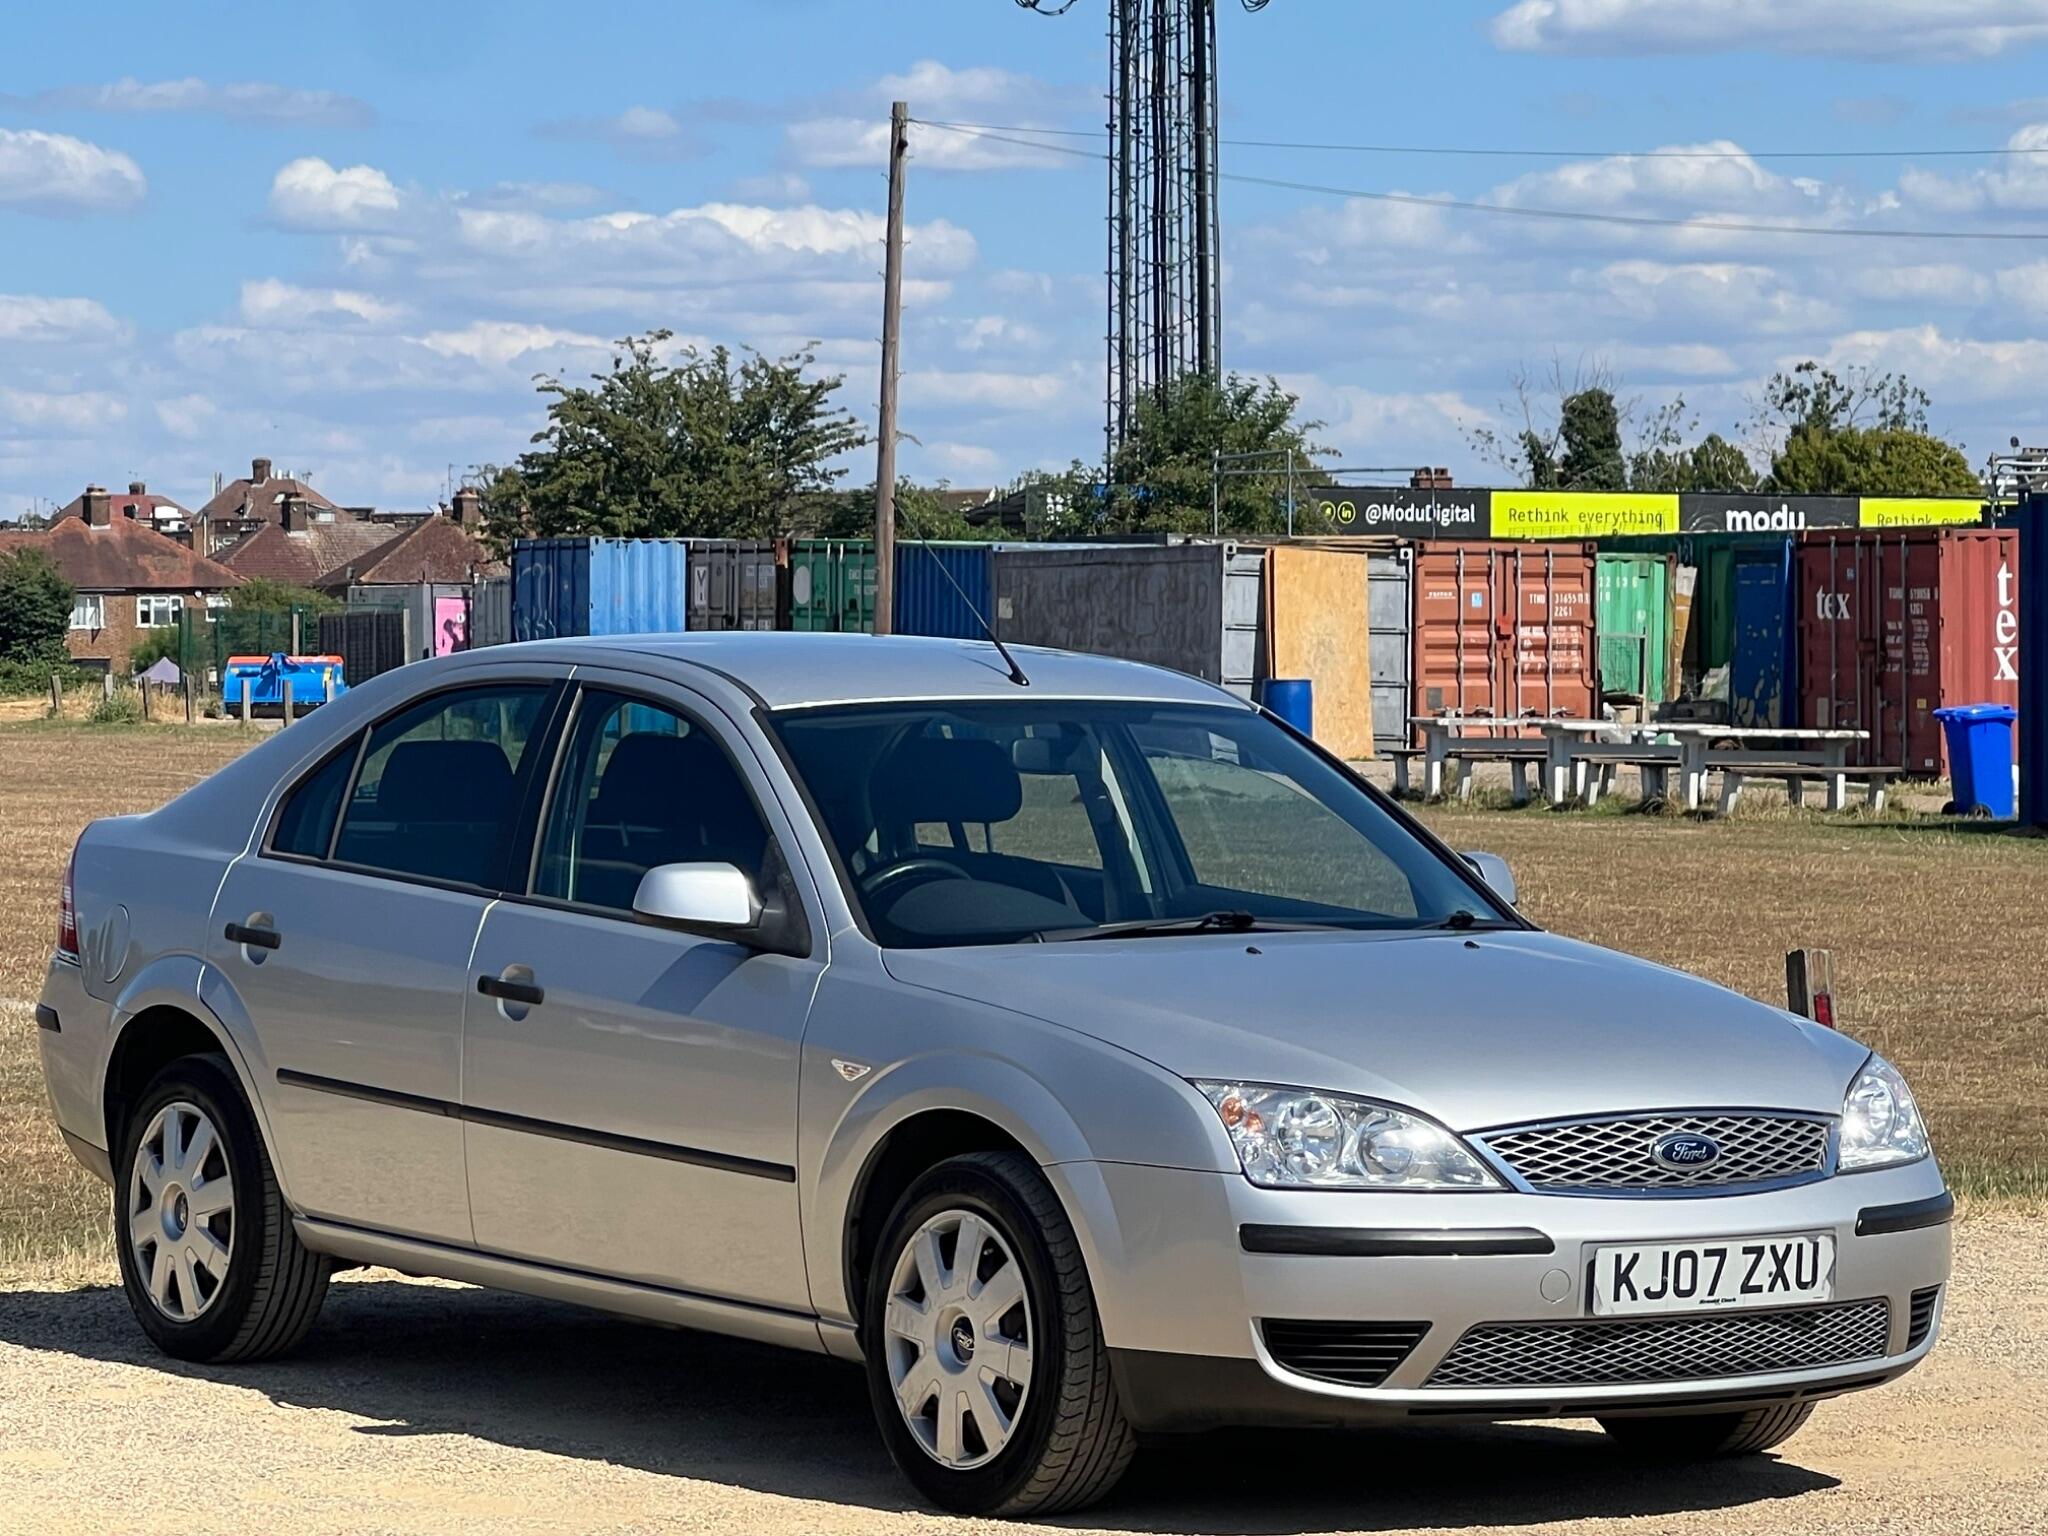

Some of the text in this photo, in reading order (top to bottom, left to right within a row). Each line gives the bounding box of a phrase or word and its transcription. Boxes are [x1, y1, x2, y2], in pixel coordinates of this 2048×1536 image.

[1365, 503, 1475, 526] @ModuDigital
[1508, 507, 1663, 528] Rethink everything
[1726, 504, 1805, 531] modu
[1816, 585, 1851, 620] tex
[1993, 561, 2019, 681] tex
[1672, 1142, 1707, 1160] Ford
[1740, 1242, 1819, 1294] ZXU
